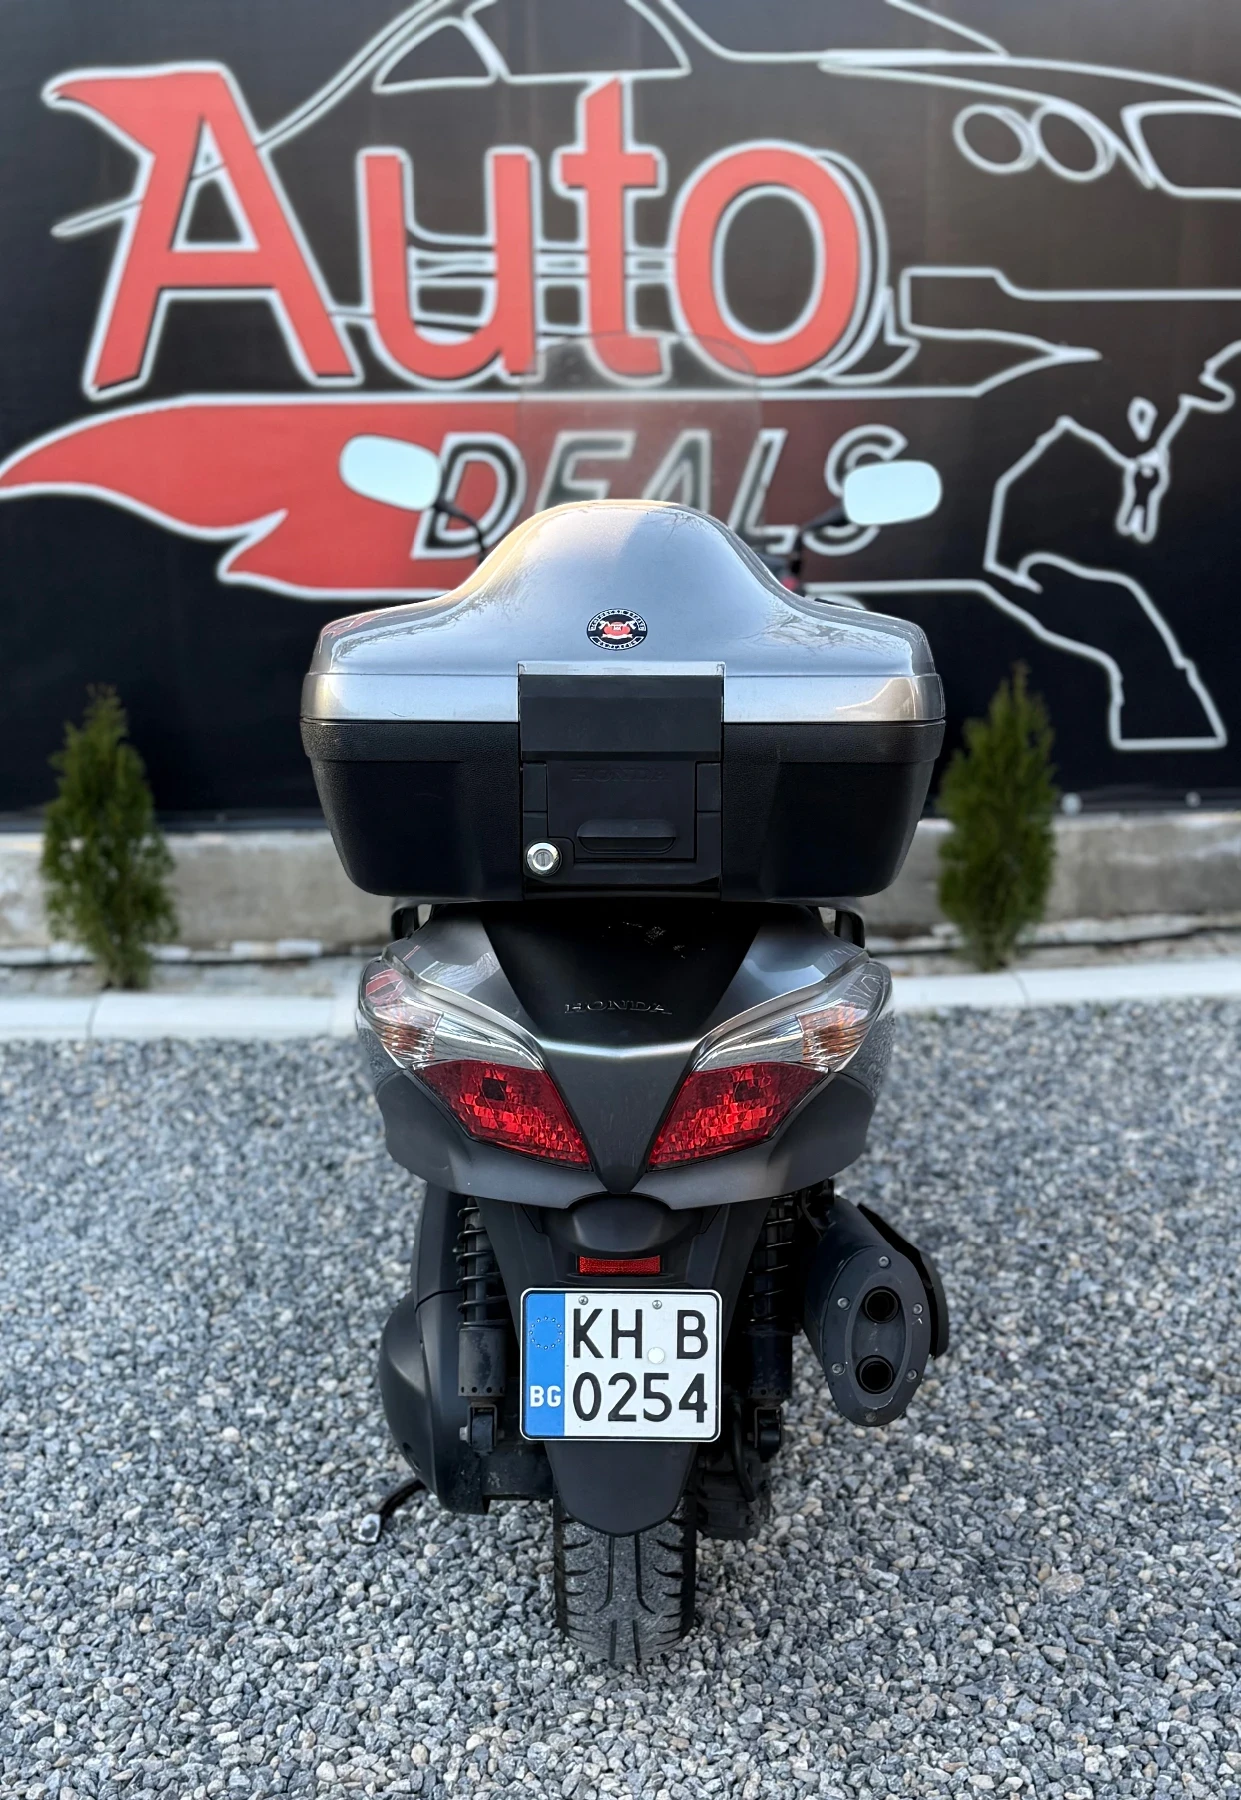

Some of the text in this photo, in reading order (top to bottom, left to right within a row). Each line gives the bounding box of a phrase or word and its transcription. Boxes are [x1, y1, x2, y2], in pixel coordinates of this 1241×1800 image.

[43, 63, 872, 399] Auto
[412, 425, 909, 561] DEALS
[570, 766, 673, 782] HONDA
[563, 999, 673, 1015] HONDA
[573, 1309, 709, 1359] KH B
[530, 1386, 561, 1408] BG
[572, 1372, 709, 1424] 0254
